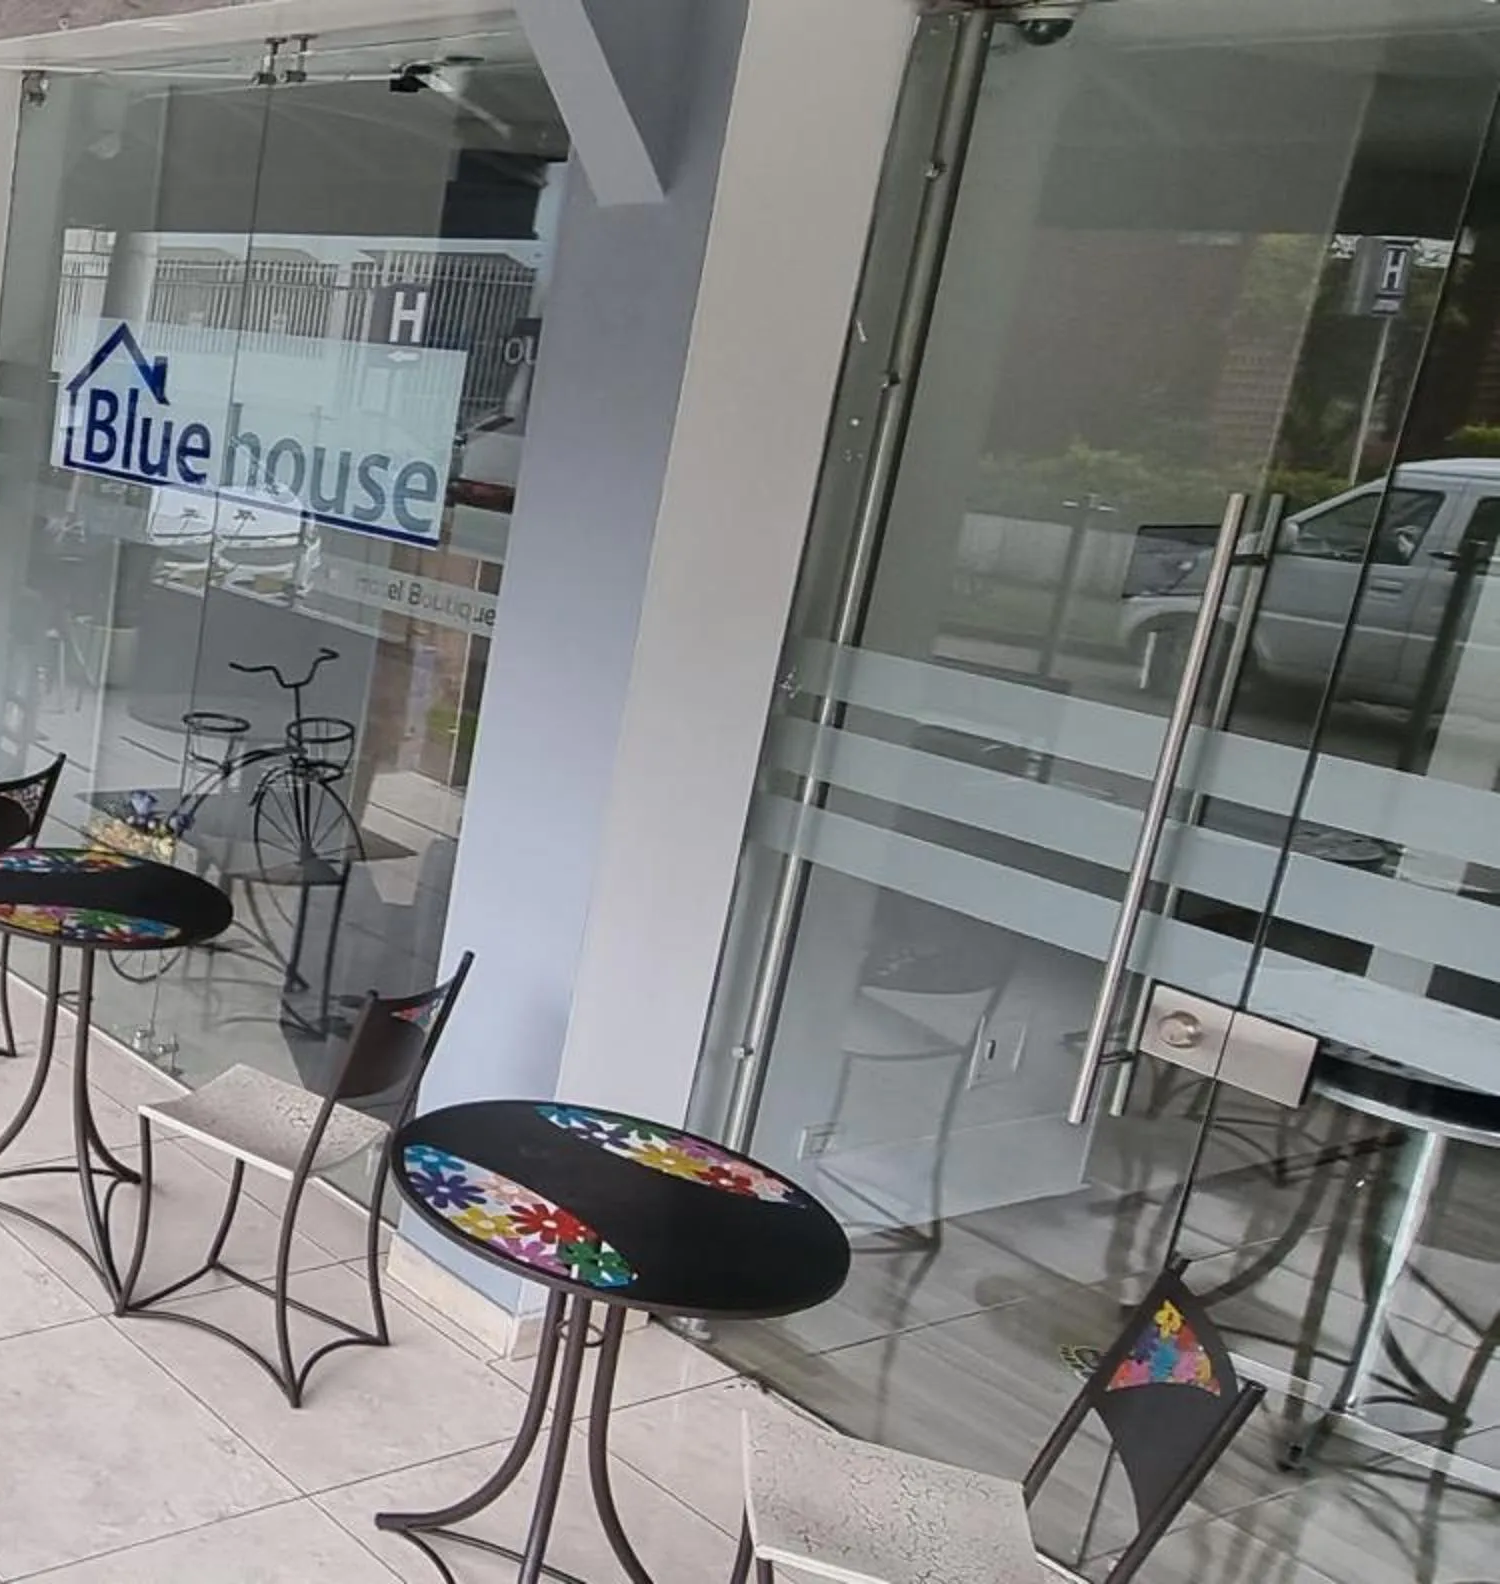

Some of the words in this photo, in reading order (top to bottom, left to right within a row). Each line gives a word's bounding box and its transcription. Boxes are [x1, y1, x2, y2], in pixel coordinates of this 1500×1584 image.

[389, 291, 427, 343] H
[83, 387, 212, 486] Blue
[222, 402, 439, 534] house
